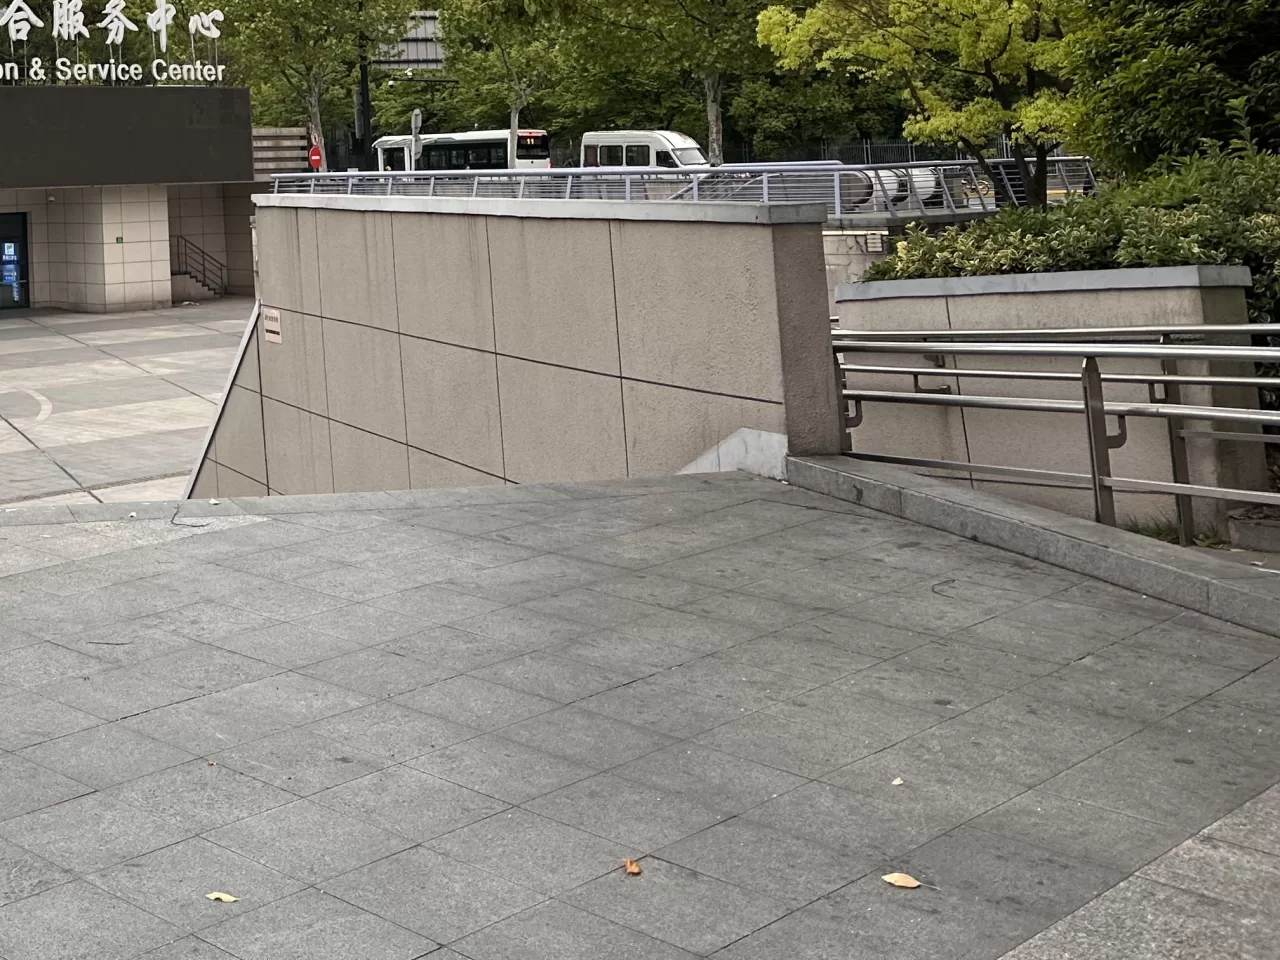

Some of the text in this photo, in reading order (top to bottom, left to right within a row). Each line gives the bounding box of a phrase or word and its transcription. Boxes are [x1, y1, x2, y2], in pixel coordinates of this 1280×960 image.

[29, 57, 47, 81] &
[55, 58, 144, 81] Service
[152, 58, 226, 82] Center
